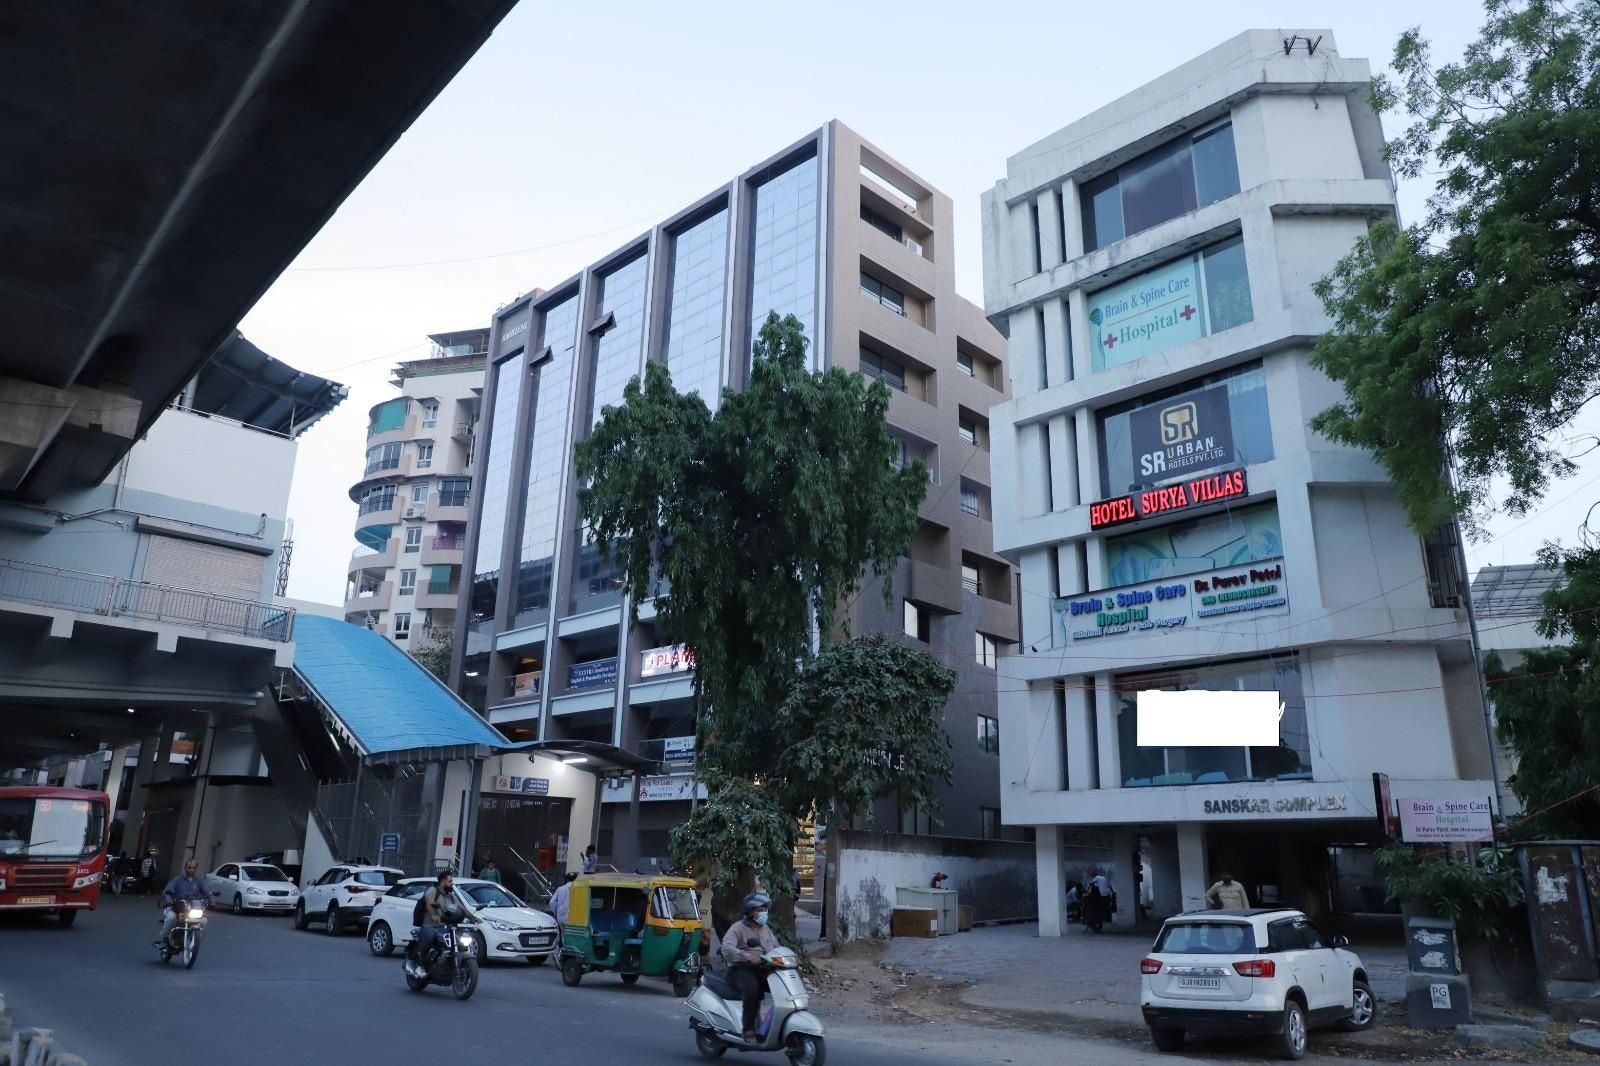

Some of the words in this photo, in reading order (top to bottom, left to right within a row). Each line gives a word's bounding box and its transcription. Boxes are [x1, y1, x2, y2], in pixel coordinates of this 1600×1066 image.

[1105, 300, 1128, 319] Brain
[1131, 294, 1138, 309] &
[1140, 287, 1166, 307] Spine
[1168, 277, 1190, 294] Care
[1119, 309, 1178, 344] Hospital
[1141, 450, 1167, 477] SR
[1167, 436, 1215, 459] URBAN
[1168, 457, 1194, 470] HOTELS
[1091, 498, 1135, 526] HOTEL
[1141, 485, 1188, 515] SURYA
[1190, 471, 1244, 503] VILLAS
[1070, 598, 1103, 616] Brain
[1105, 597, 1114, 609] &
[1117, 590, 1153, 608] Spine
[1155, 584, 1187, 602] Care
[1097, 606, 1149, 627] Hospital
[1204, 798, 1270, 814] SANSKAR
[1274, 795, 1347, 813] COMPLEX
[1413, 802, 1434, 812] Brain
[1445, 802, 1468, 814] Spine
[1470, 801, 1488, 811] Care
[1435, 815, 1469, 825] Hospital
[1432, 986, 1447, 997] PG
